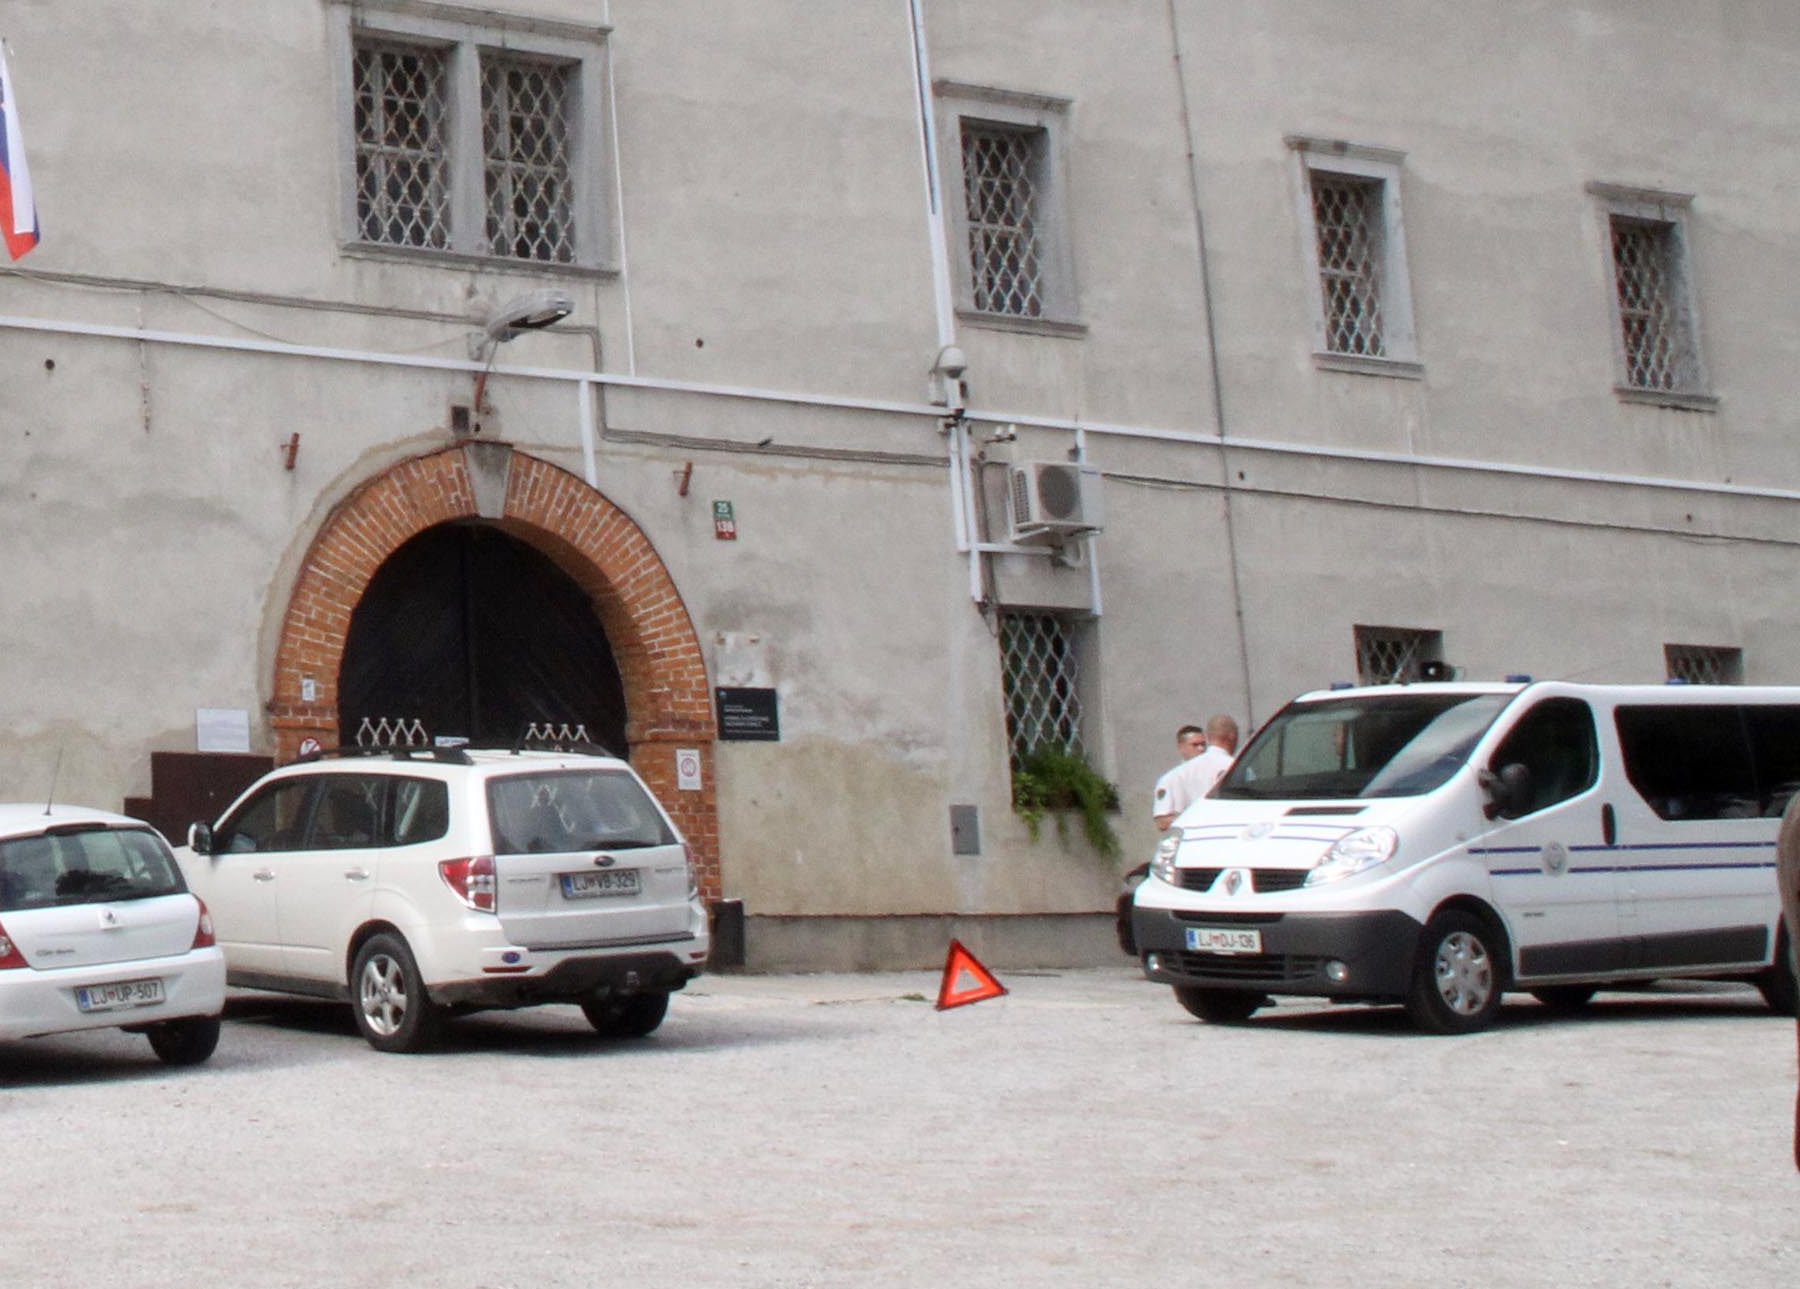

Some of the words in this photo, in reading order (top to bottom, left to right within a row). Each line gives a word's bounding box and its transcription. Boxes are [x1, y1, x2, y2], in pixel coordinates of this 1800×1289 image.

[573, 874, 588, 891] LJ
[1199, 931, 1212, 947] LJ
[89, 987, 108, 1005] LJ
[116, 982, 158, 1002] UP-507
